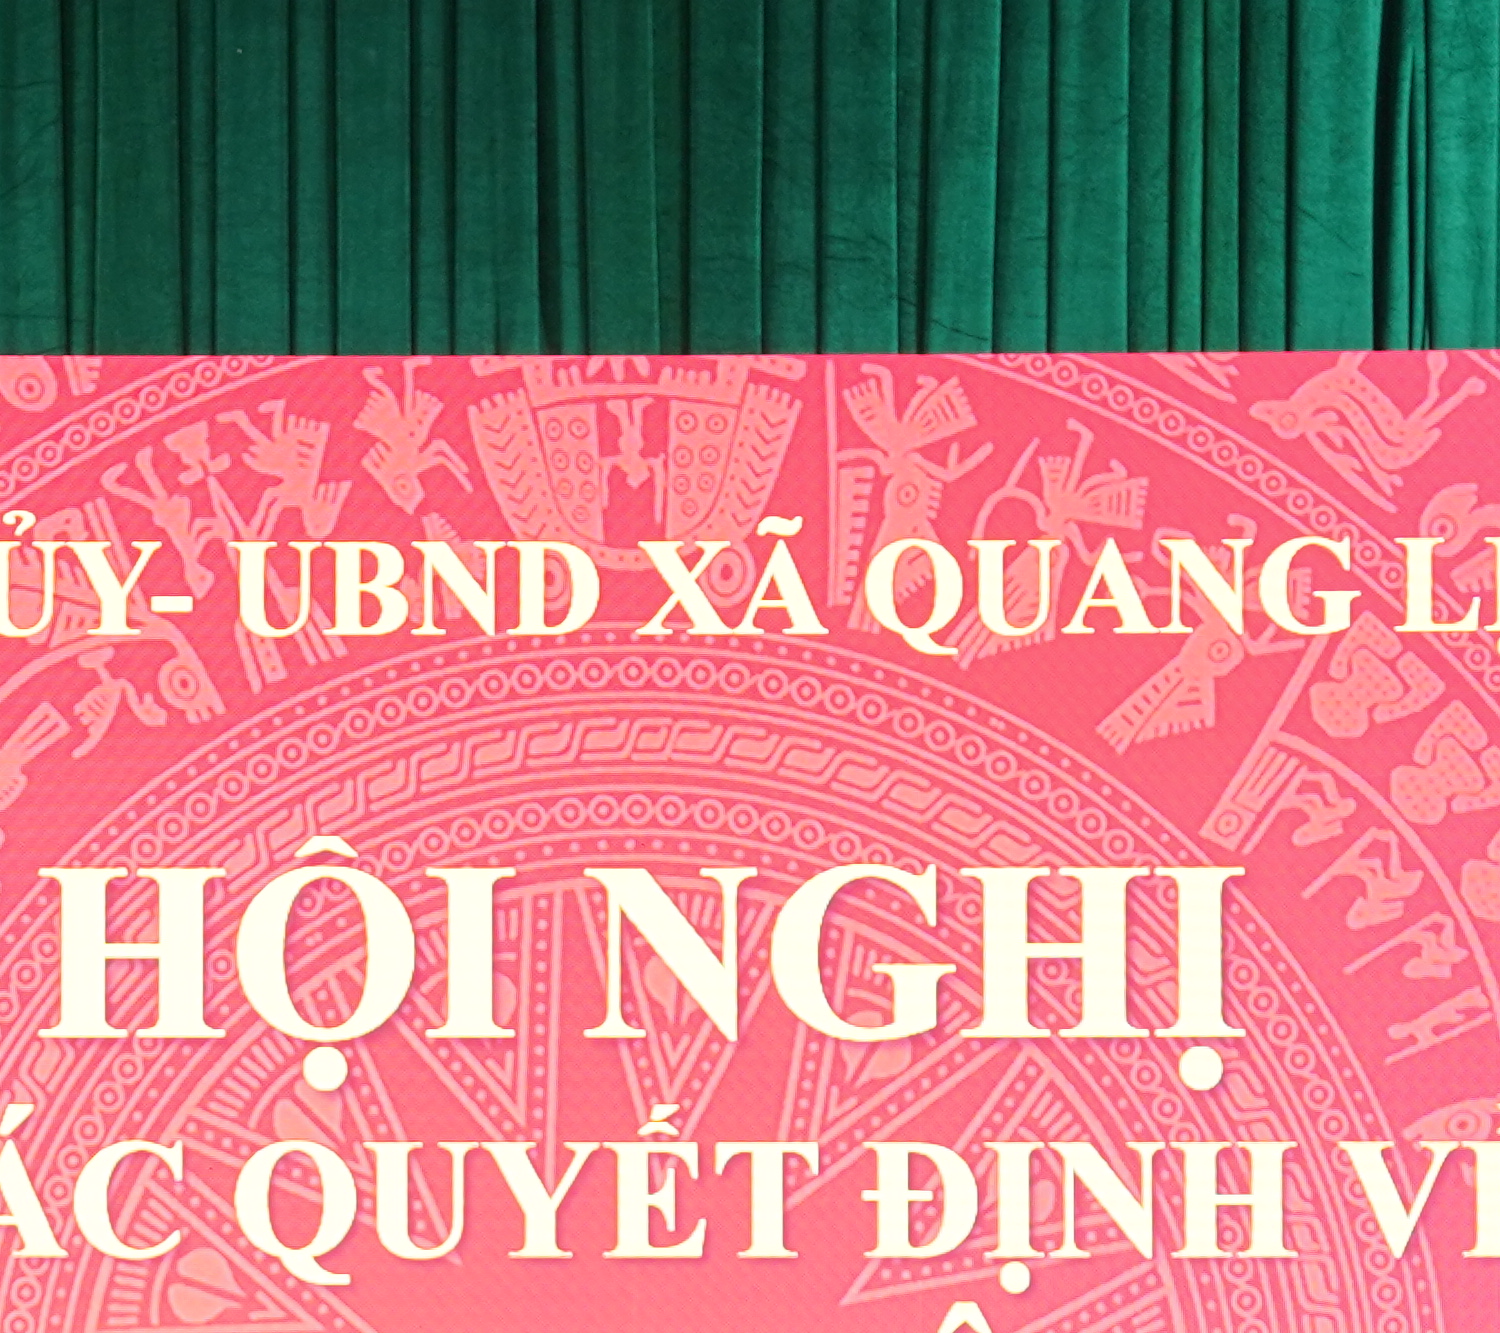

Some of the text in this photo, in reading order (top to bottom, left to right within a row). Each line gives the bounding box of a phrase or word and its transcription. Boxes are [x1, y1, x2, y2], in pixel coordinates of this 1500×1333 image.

[227, 539, 601, 638] UBND
[634, 515, 830, 636] XÃ
[864, 535, 1363, 656] QUANG
[37, 834, 1247, 1092] HỘI NGHỊ
[233, 1103, 820, 1286] QUYẾT
[860, 1140, 1299, 1294] ĐỊNH
